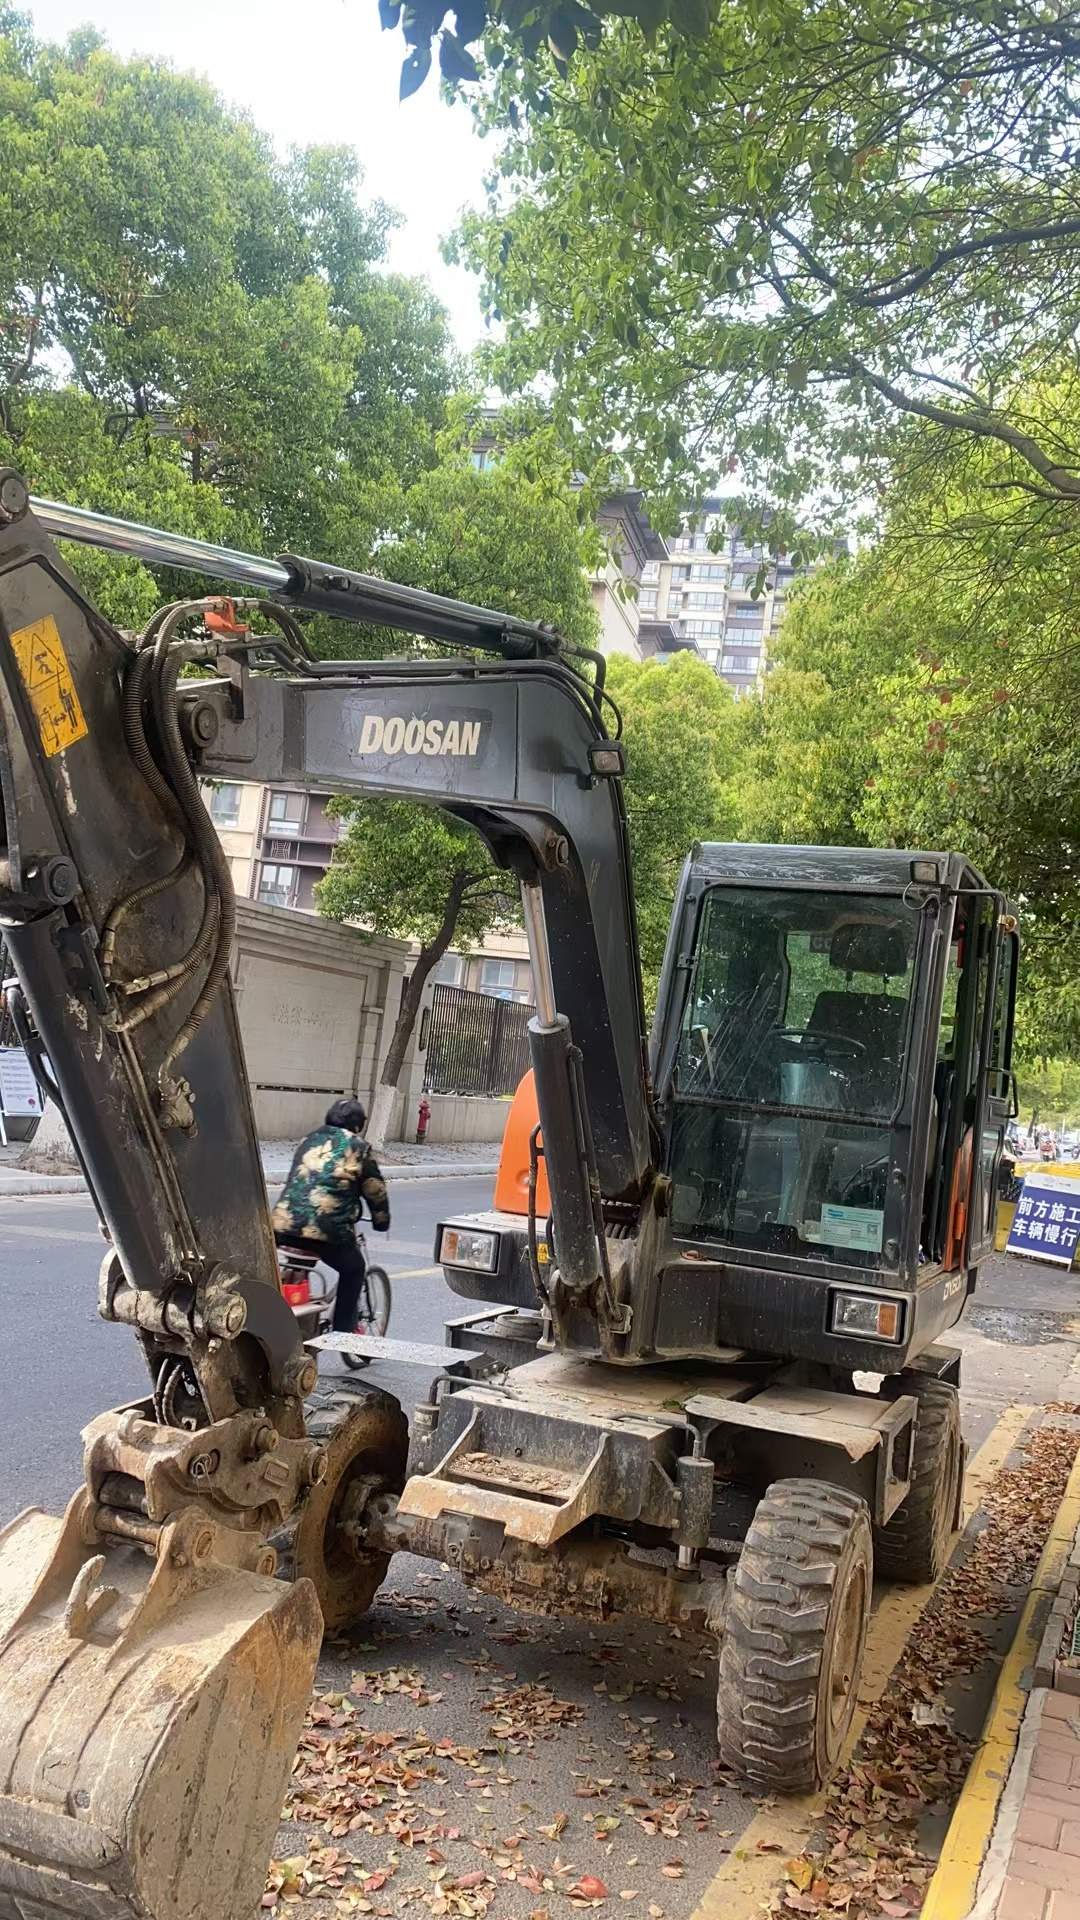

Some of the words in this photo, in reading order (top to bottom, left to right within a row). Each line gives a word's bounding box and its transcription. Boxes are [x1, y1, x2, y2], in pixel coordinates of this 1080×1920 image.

[358, 715, 481, 756] DOOSAN
[1018, 1197, 1080, 1225] 前方施工
[1012, 1218, 1077, 1247] 车辆慢行
